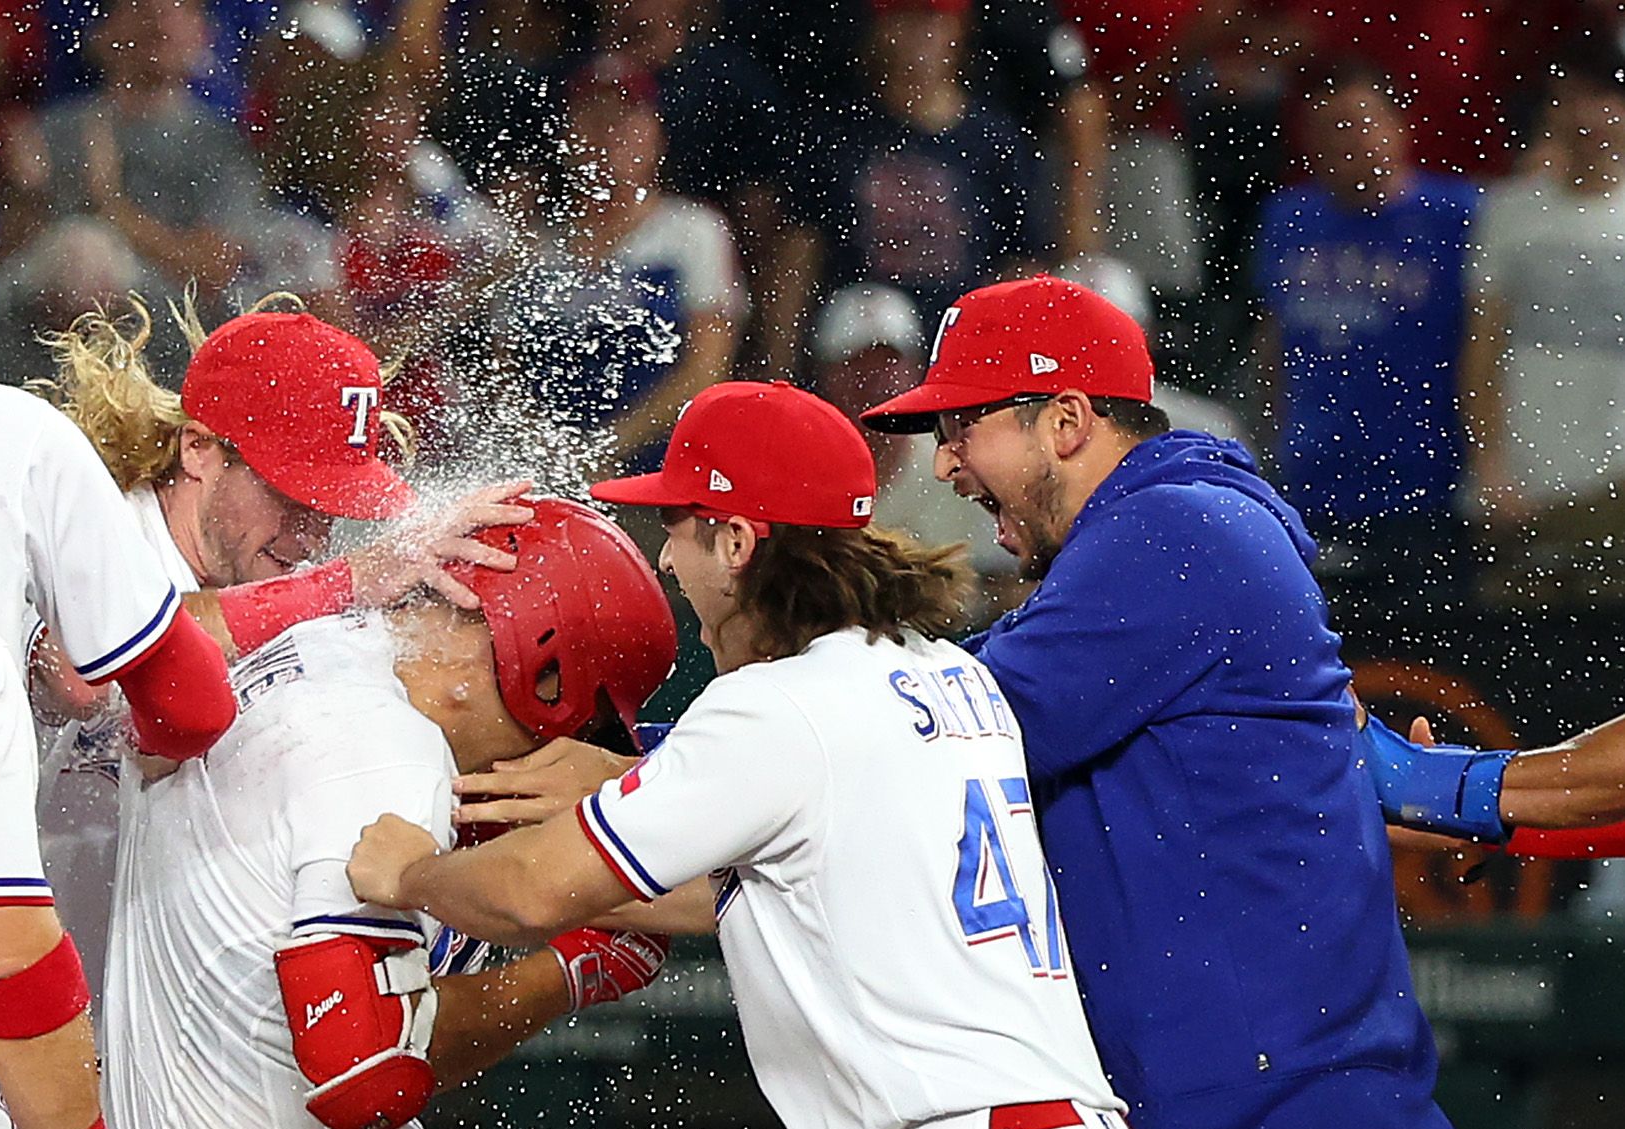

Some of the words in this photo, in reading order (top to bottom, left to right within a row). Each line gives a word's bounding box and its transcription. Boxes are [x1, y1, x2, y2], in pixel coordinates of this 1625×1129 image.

[341, 386, 377, 448] T
[949, 776, 1069, 980] 47
[306, 990, 343, 1030] Lowe
